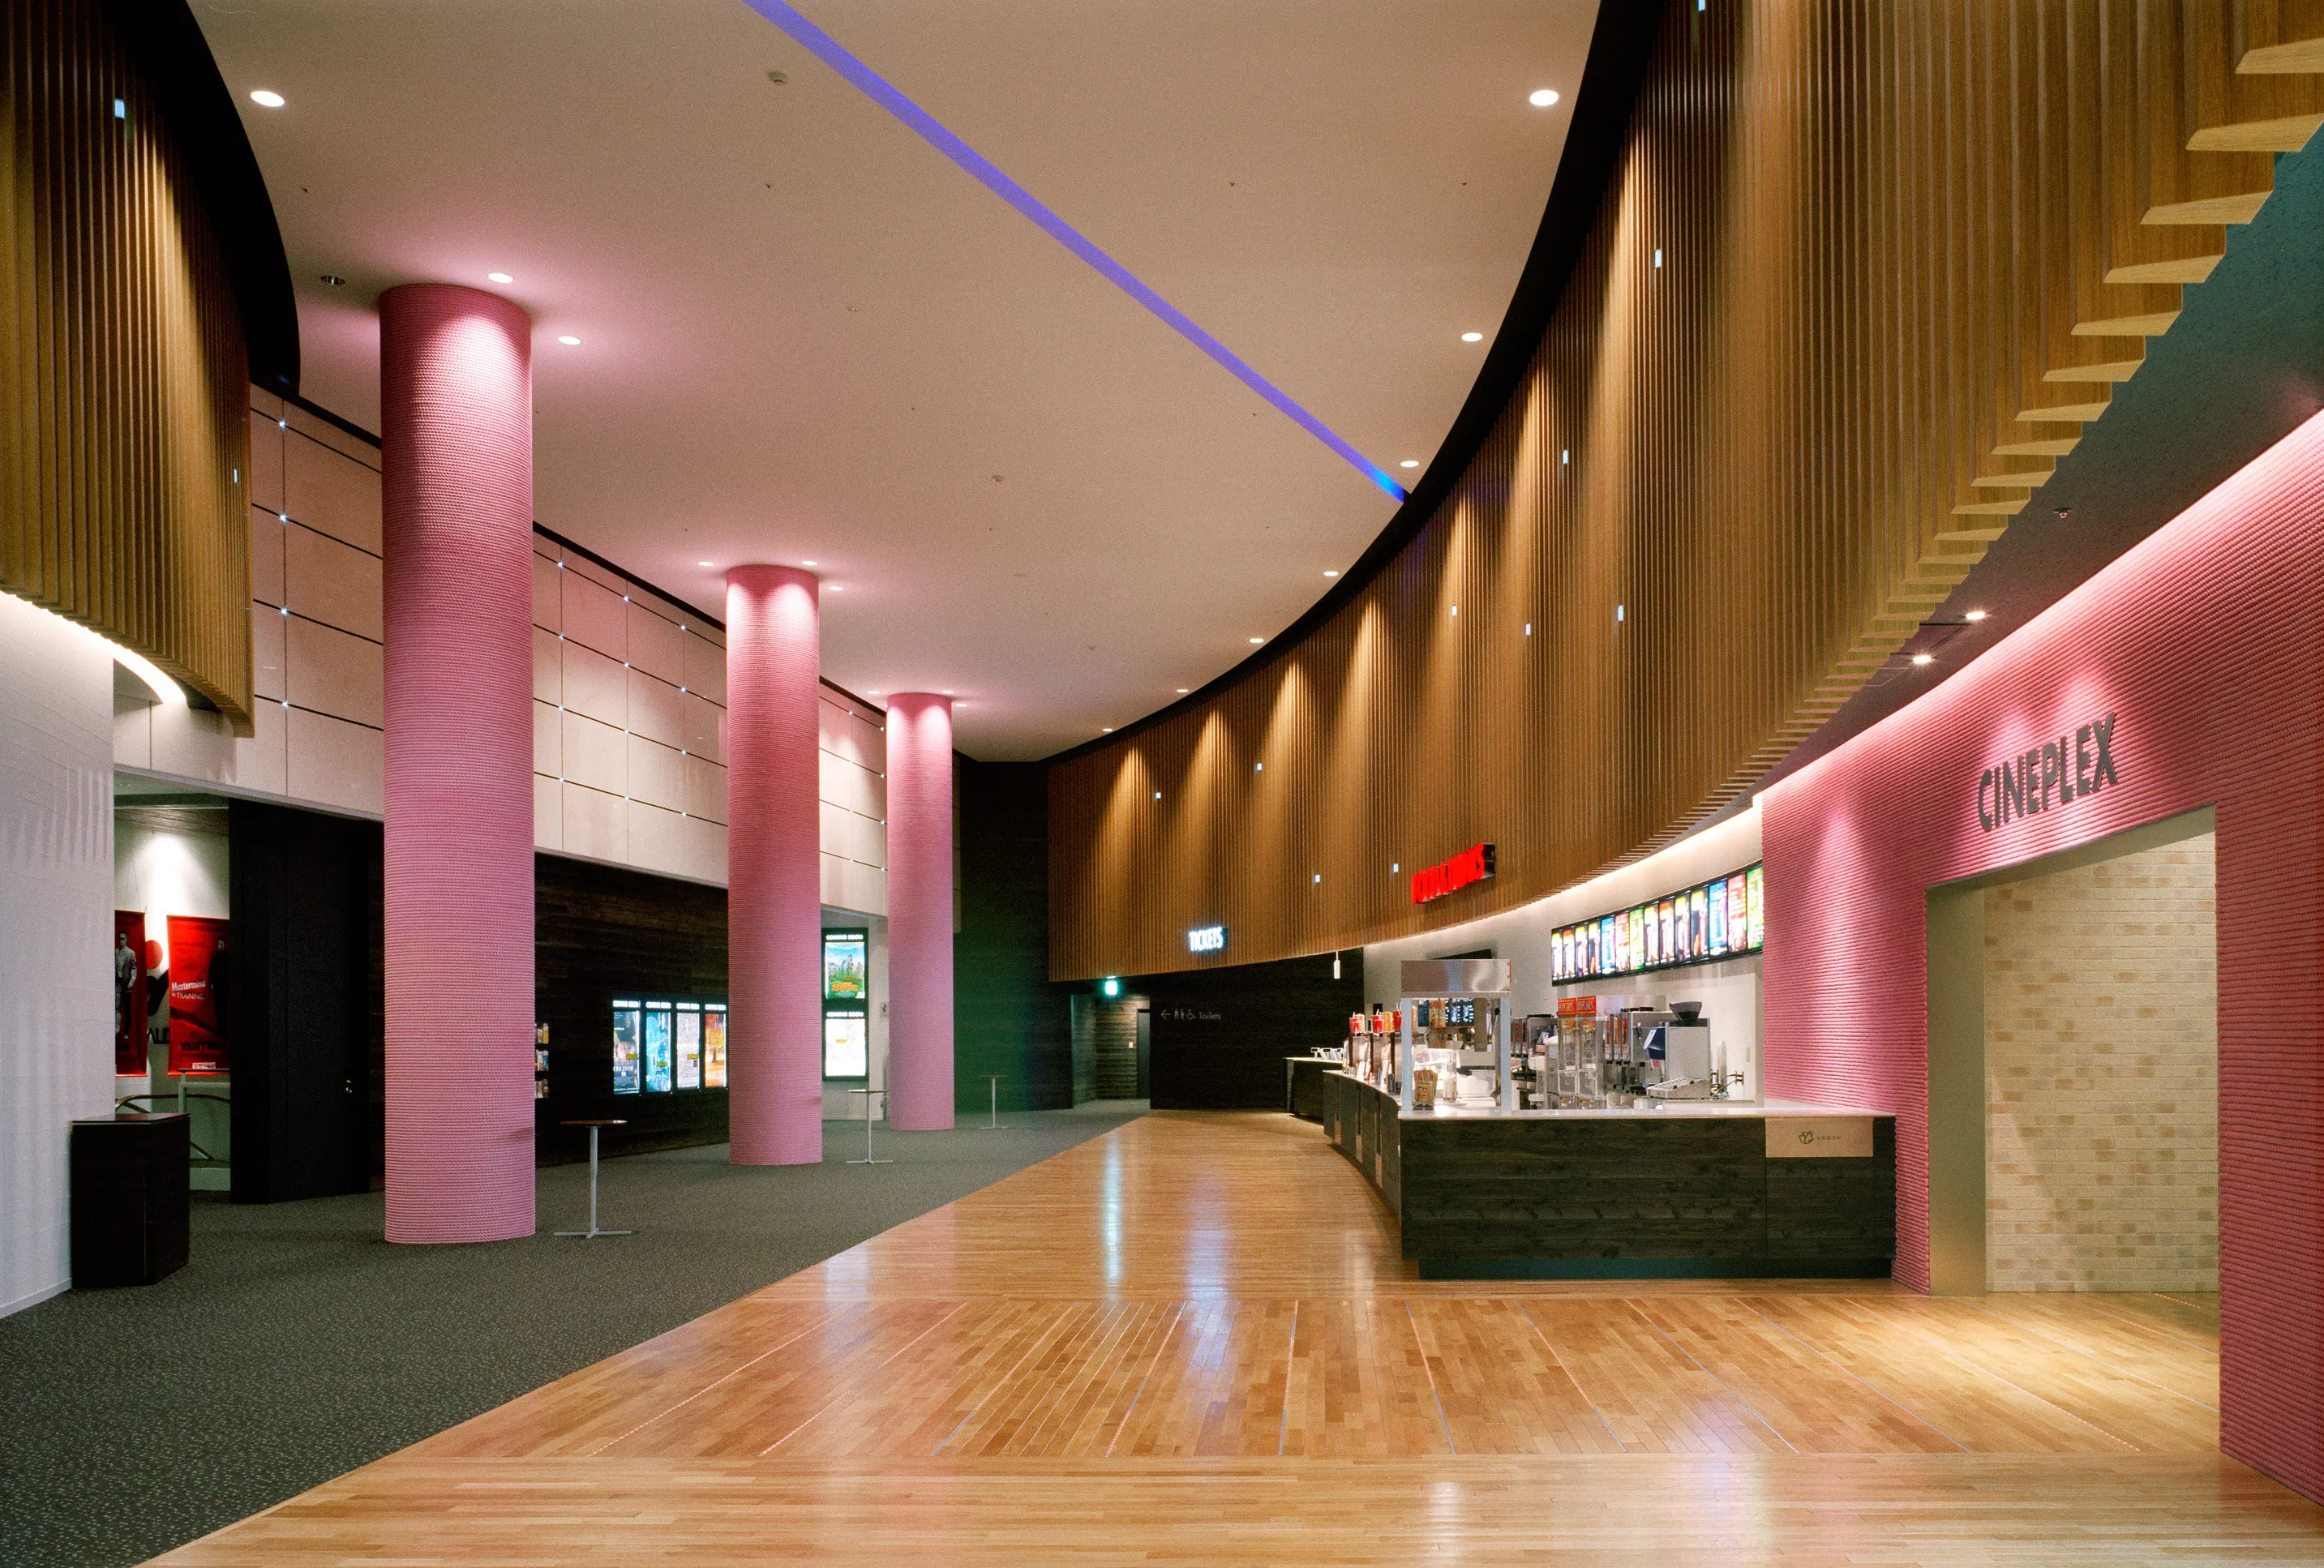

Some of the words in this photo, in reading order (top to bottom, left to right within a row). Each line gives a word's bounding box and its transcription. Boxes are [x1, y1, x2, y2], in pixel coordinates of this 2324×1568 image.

[1978, 712, 2118, 833] CINEPLEX
[1412, 865, 1439, 904] FOOD
[1189, 926, 1223, 952] TICKETS
[171, 977, 206, 992] Mastermind
[177, 992, 204, 1000] TRAINING
[1198, 1010, 1222, 1020] Toilets
